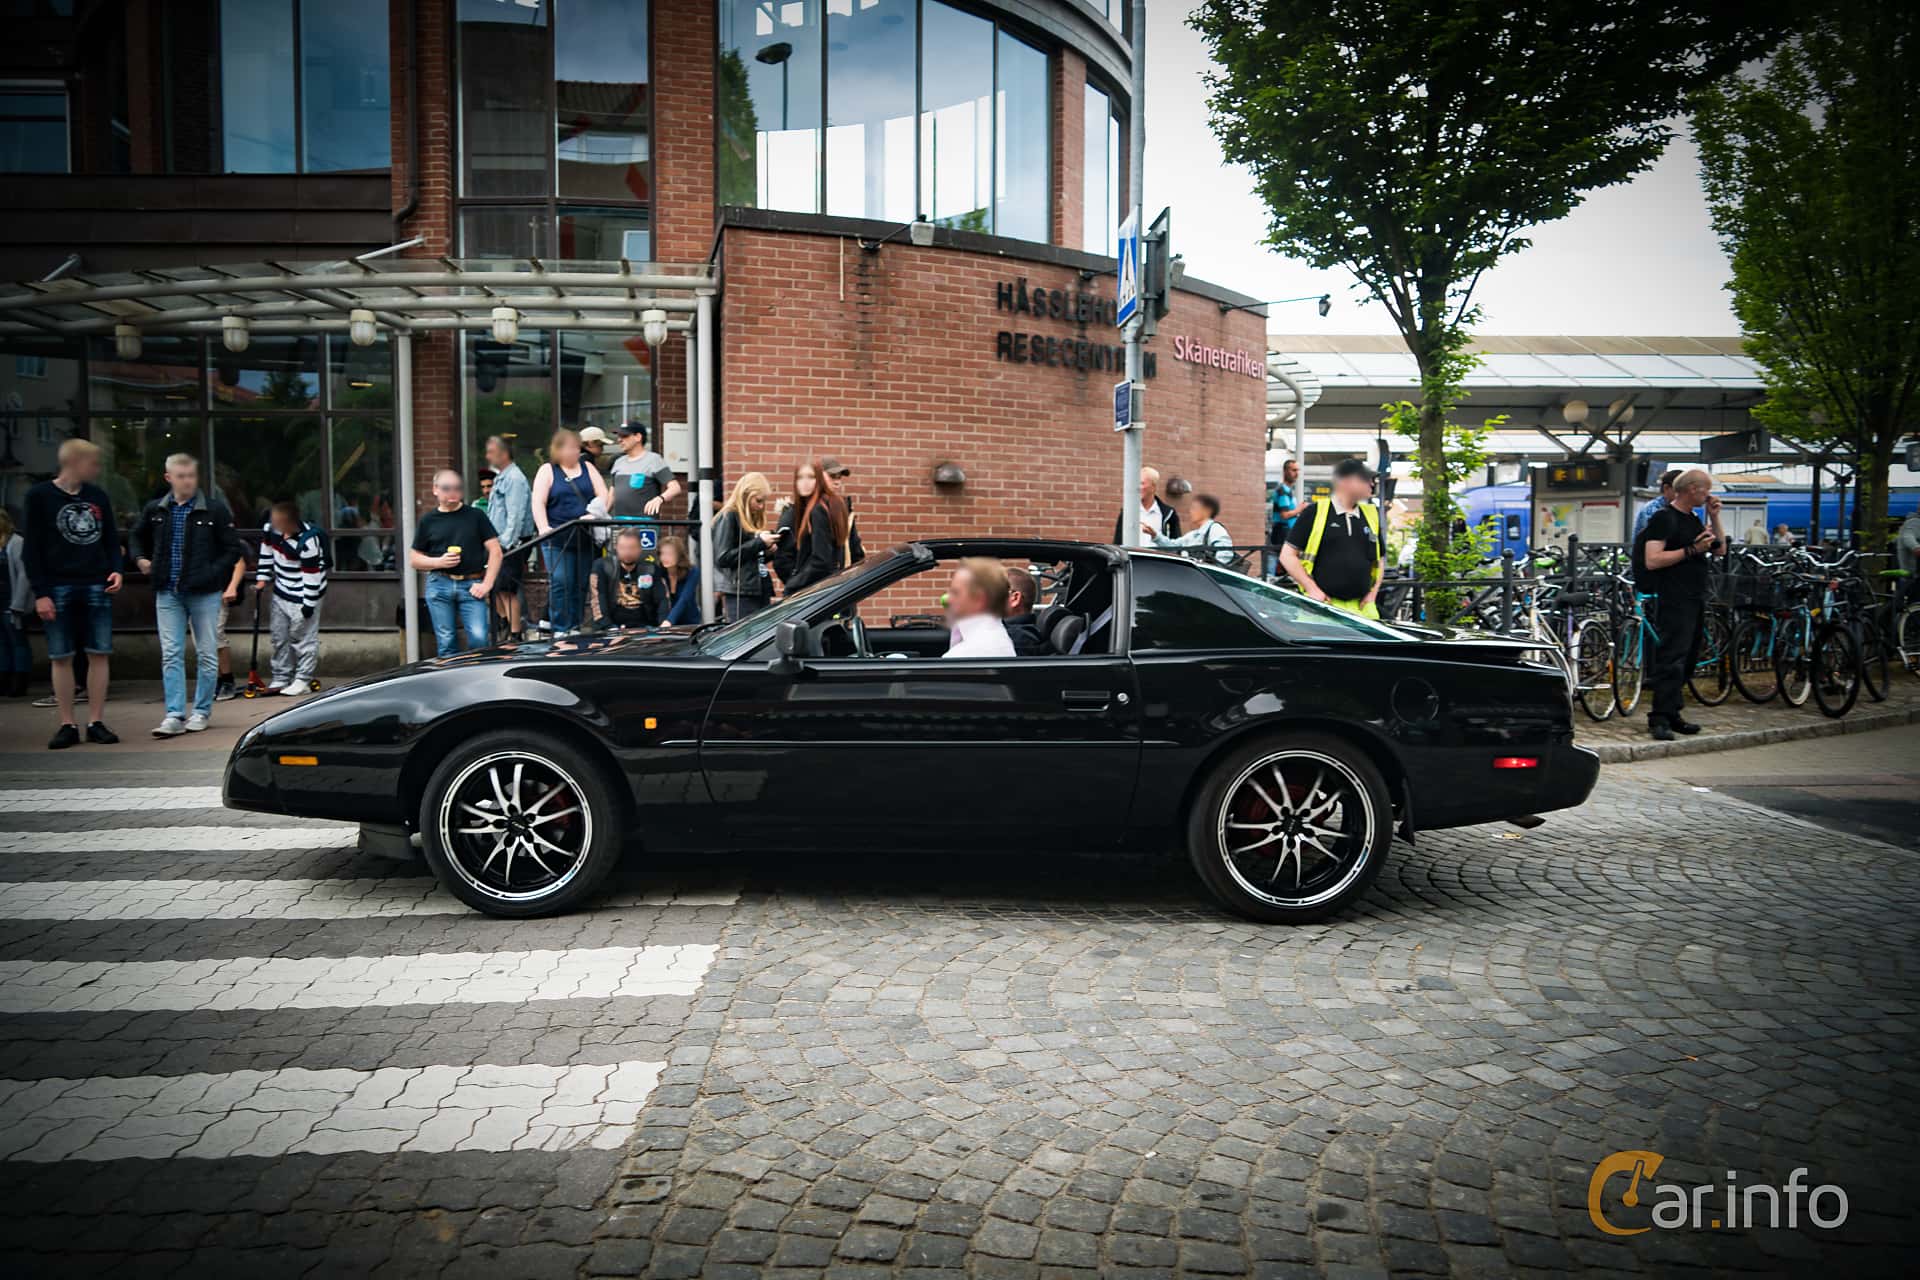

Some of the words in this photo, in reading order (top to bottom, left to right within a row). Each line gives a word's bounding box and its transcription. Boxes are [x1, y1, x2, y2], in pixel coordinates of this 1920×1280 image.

[997, 277, 1118, 326] HÄSSLEHO
[997, 331, 1157, 378] RESECENTM
[1173, 335, 1265, 380] Skånetrafiken
[1748, 433, 1759, 453] A
